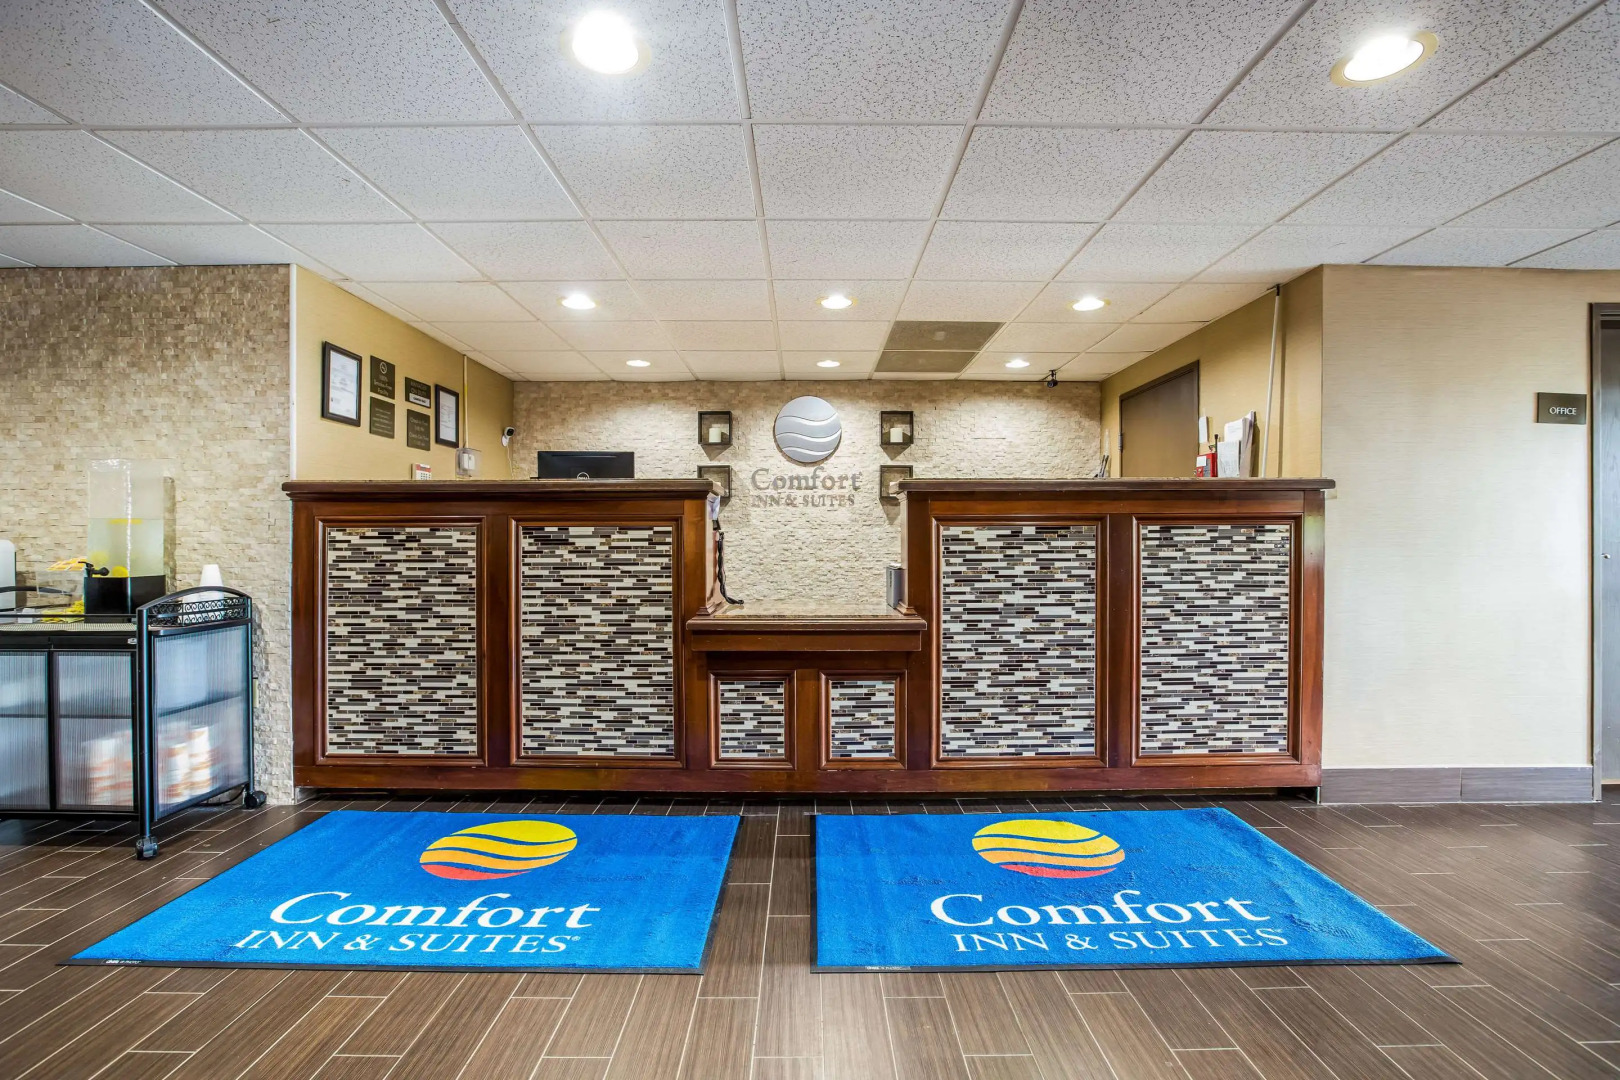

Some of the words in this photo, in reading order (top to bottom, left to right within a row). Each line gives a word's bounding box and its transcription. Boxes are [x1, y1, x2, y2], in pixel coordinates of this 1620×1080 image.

[1549, 406, 1577, 416] OFFICE
[751, 466, 860, 491] Comfort
[751, 495, 780, 508] INN
[785, 494, 799, 507] &
[803, 494, 855, 507] SUITES
[270, 891, 600, 928] Comfort
[930, 889, 1270, 927] Comfort
[231, 930, 342, 950] INN
[343, 934, 382, 950] &
[951, 932, 1049, 951] INN
[1065, 933, 1098, 950] &
[1109, 928, 1288, 949] SUITES
